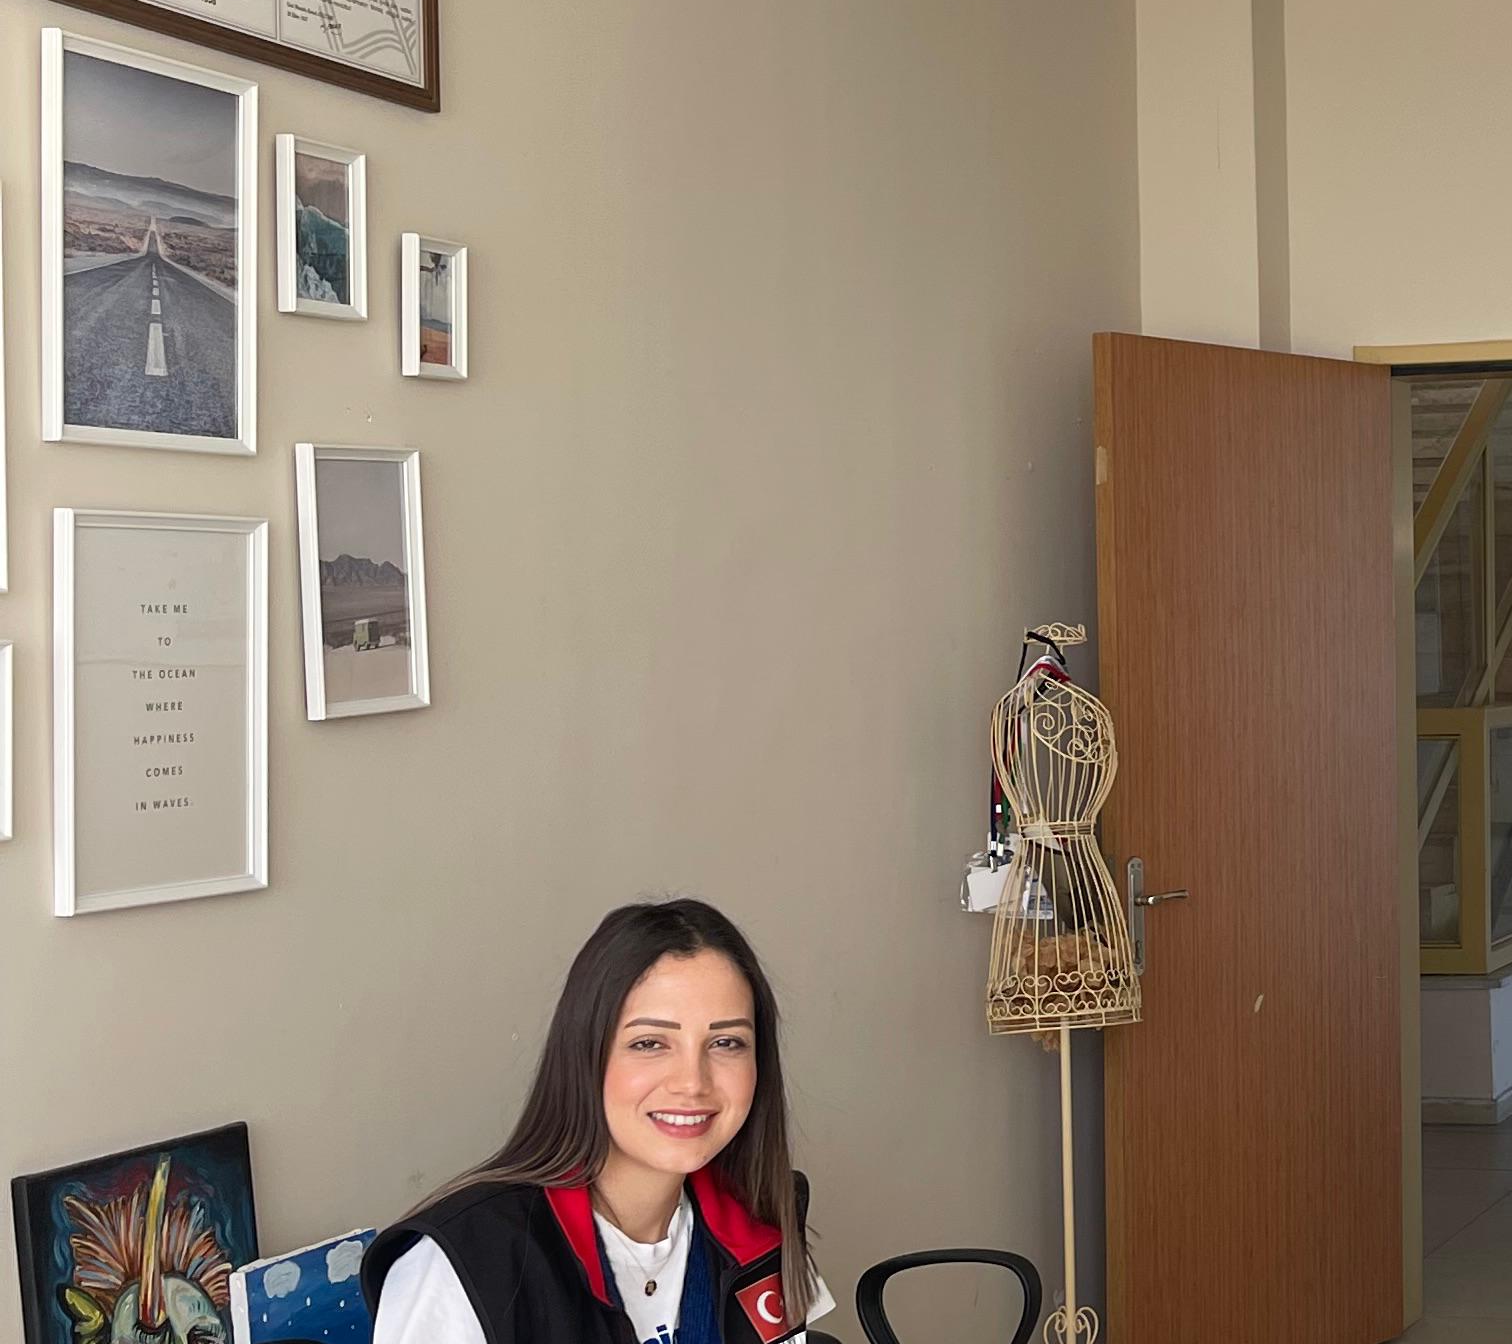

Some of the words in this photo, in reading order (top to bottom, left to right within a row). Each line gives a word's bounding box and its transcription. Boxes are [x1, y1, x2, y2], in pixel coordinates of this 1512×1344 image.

[140, 604, 168, 615] TAKE
[173, 604, 188, 614] ME
[157, 637, 172, 647] TO
[132, 670, 153, 680] THE
[158, 669, 196, 679] OCEAN
[145, 701, 183, 712] WHERE
[133, 733, 195, 745] HAPPINESS
[145, 766, 184, 778] COMES
[135, 802, 147, 811] IN
